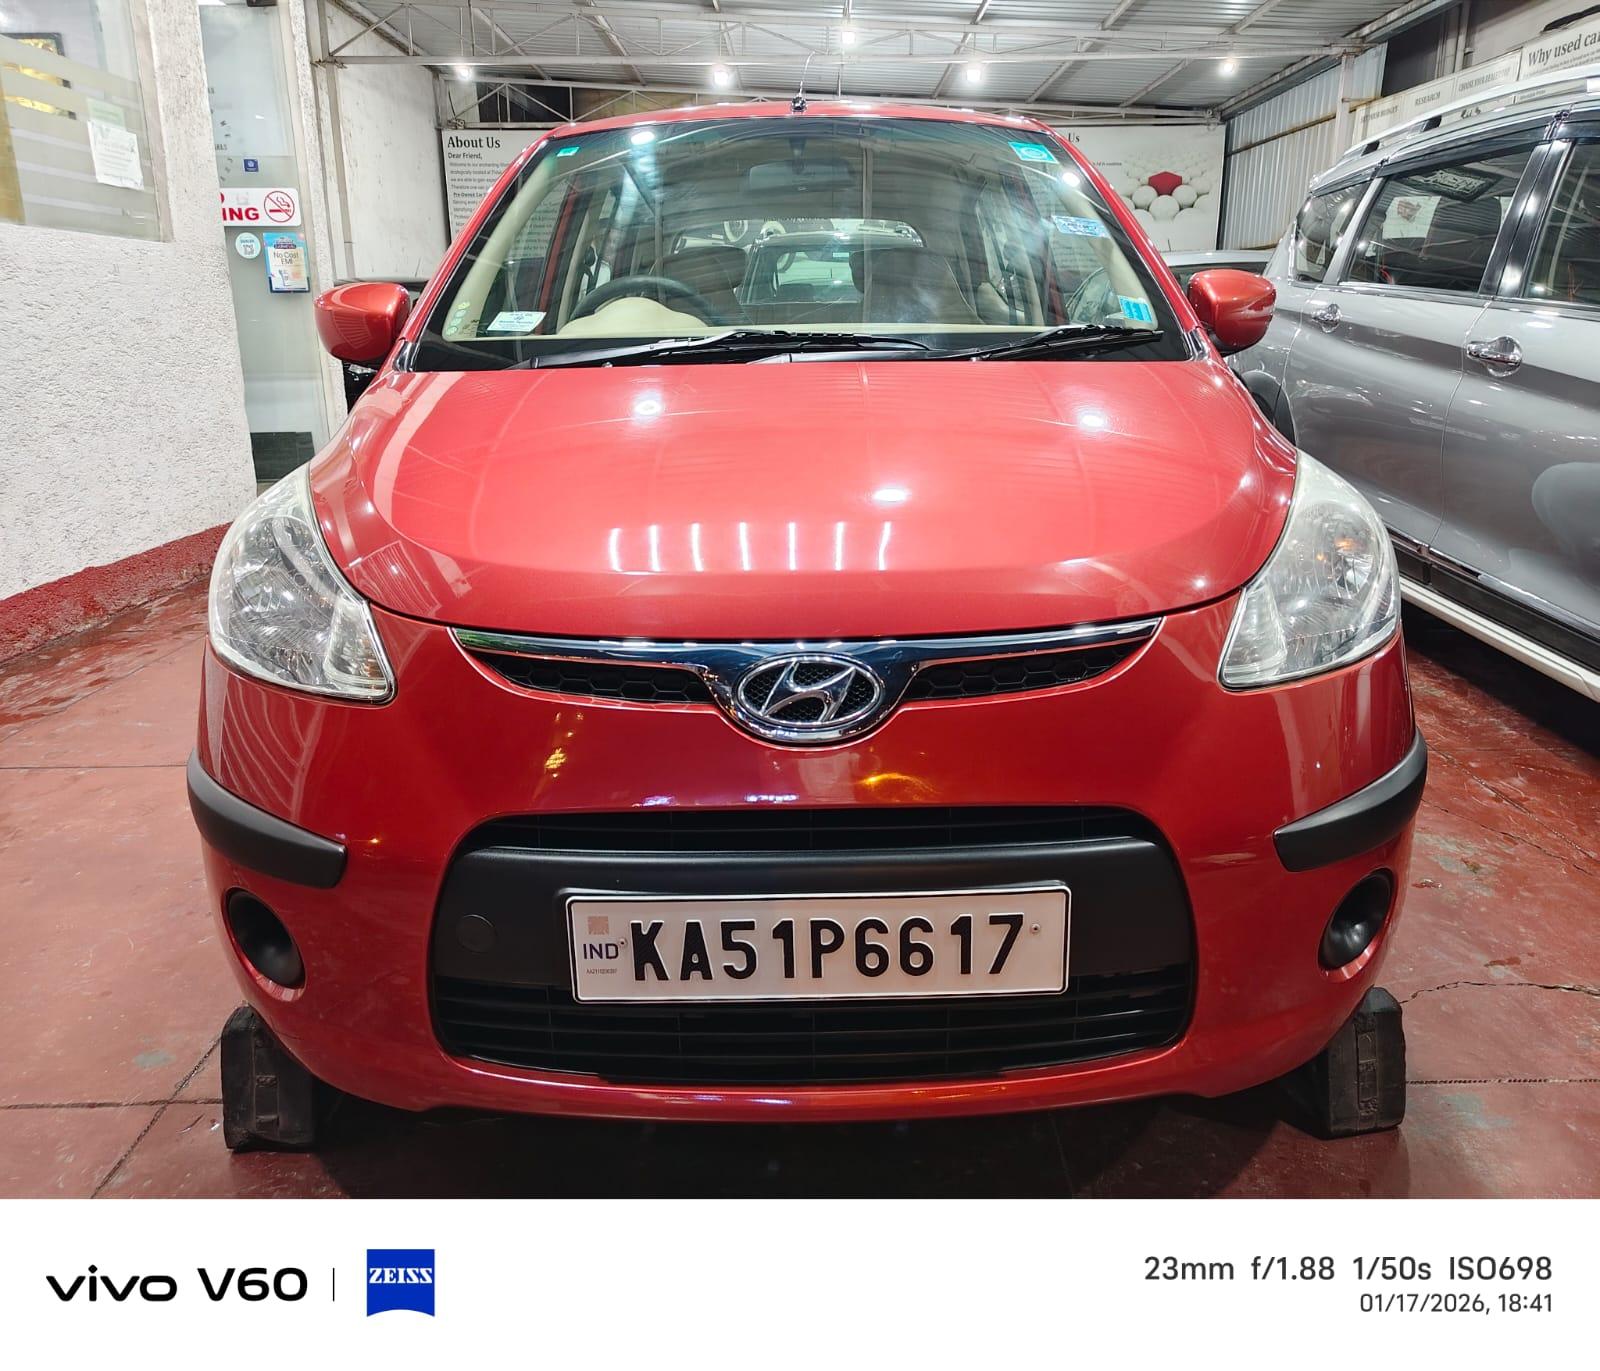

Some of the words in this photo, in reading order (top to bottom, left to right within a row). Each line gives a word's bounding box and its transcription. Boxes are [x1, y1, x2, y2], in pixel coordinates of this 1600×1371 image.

[1528, 48, 1552, 66] Why
[1554, 34, 1582, 58] used
[1415, 92, 1441, 105] RESEARCH
[448, 136, 483, 148] About
[486, 136, 501, 149] Us
[1068, 132, 1080, 143] Us
[462, 152, 483, 160] Friend,
[222, 207, 259, 221] ING
[583, 943, 619, 959] IND
[629, 914, 1025, 982] KA51P6617
